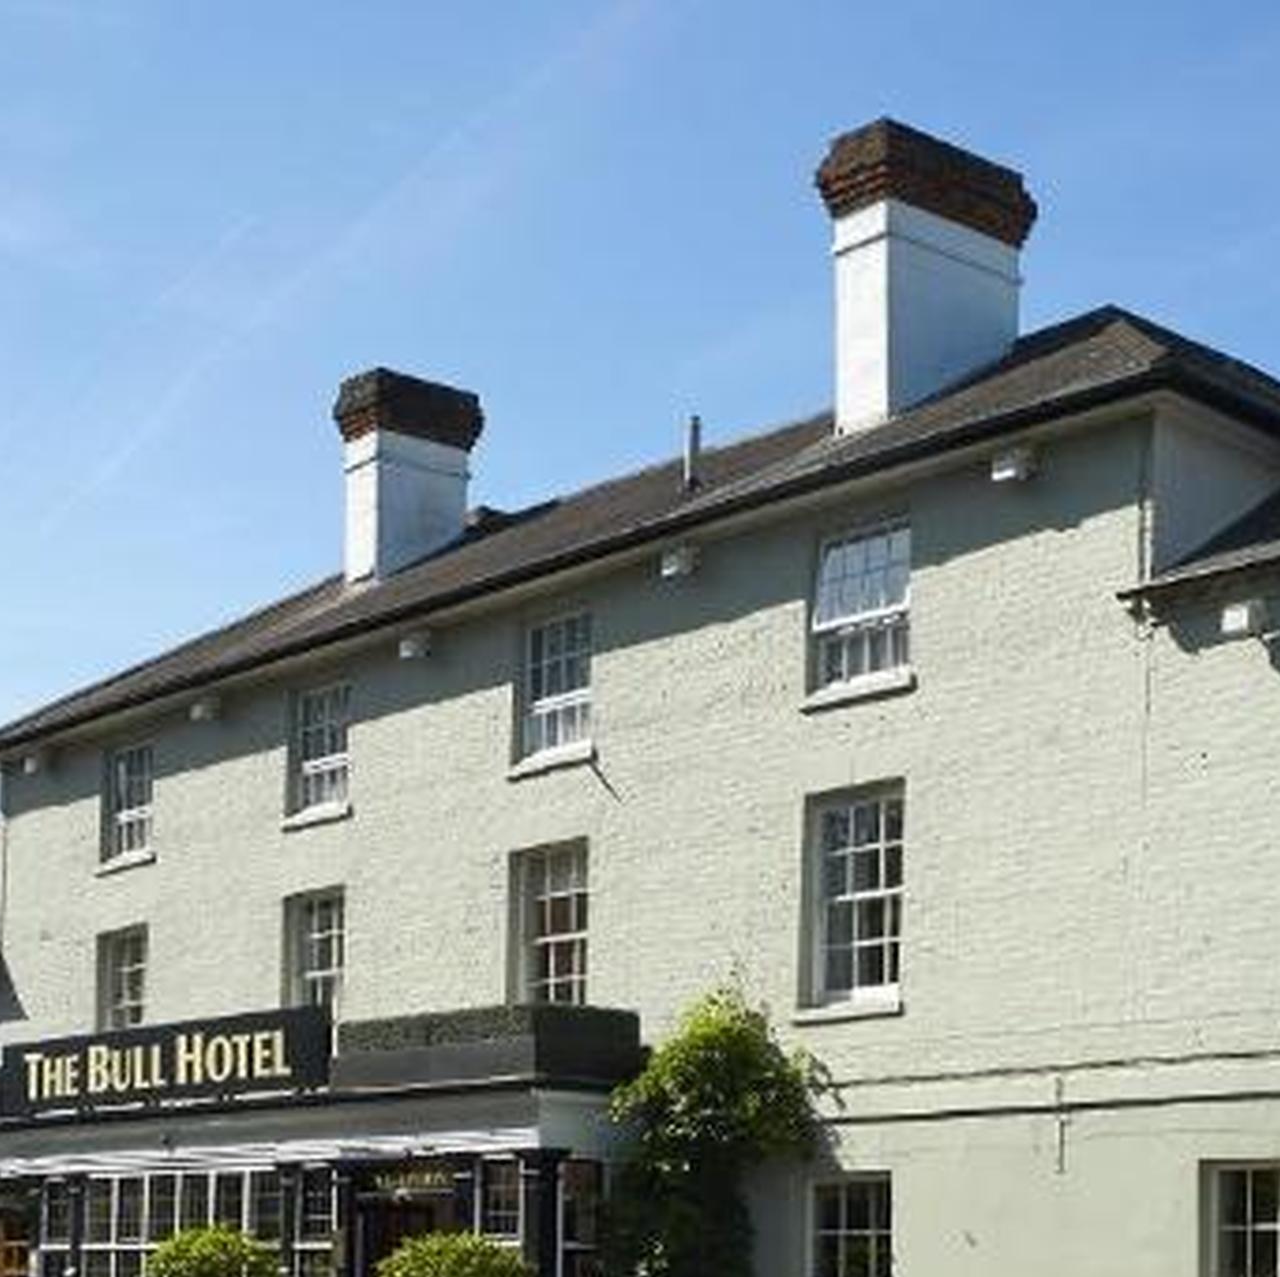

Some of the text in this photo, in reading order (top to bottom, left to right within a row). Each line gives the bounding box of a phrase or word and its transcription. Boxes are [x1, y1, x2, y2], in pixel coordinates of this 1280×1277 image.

[23, 1029, 292, 1101] THE BULL HOTEL
